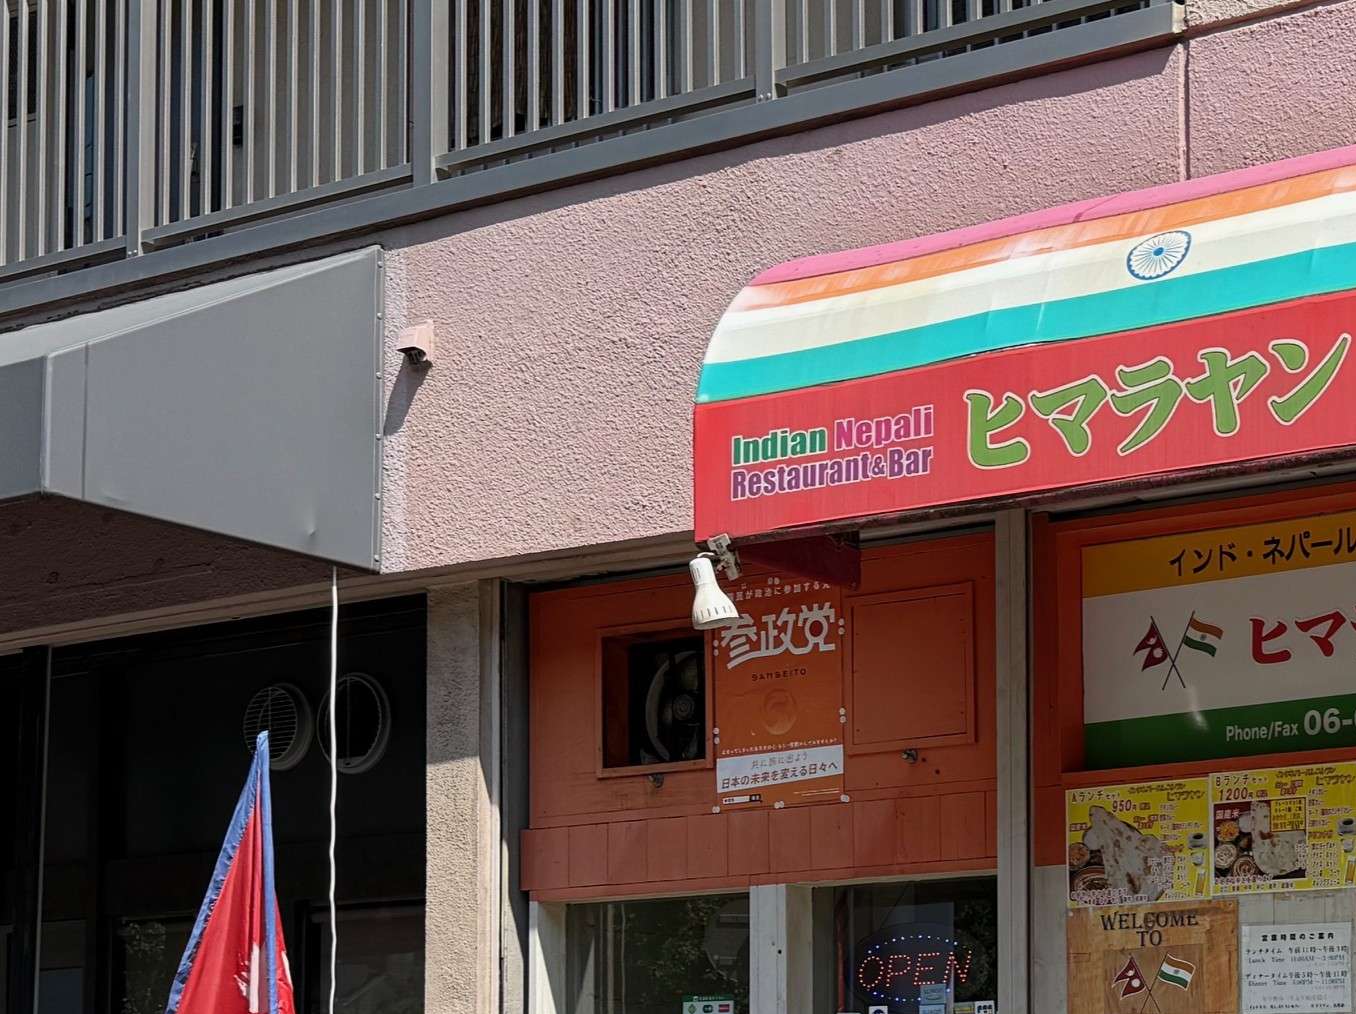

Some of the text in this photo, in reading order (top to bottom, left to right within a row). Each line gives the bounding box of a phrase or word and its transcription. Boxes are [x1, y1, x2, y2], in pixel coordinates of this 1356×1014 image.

[963, 332, 1352, 470] ヒマラヤン
[732, 405, 934, 466] Indian Nepali
[1226, 720, 1299, 743] Phone/Fax
[1101, 912, 1199, 931] WELCOME
[1136, 930, 1162, 947] TO
[859, 951, 973, 992] OPEN
